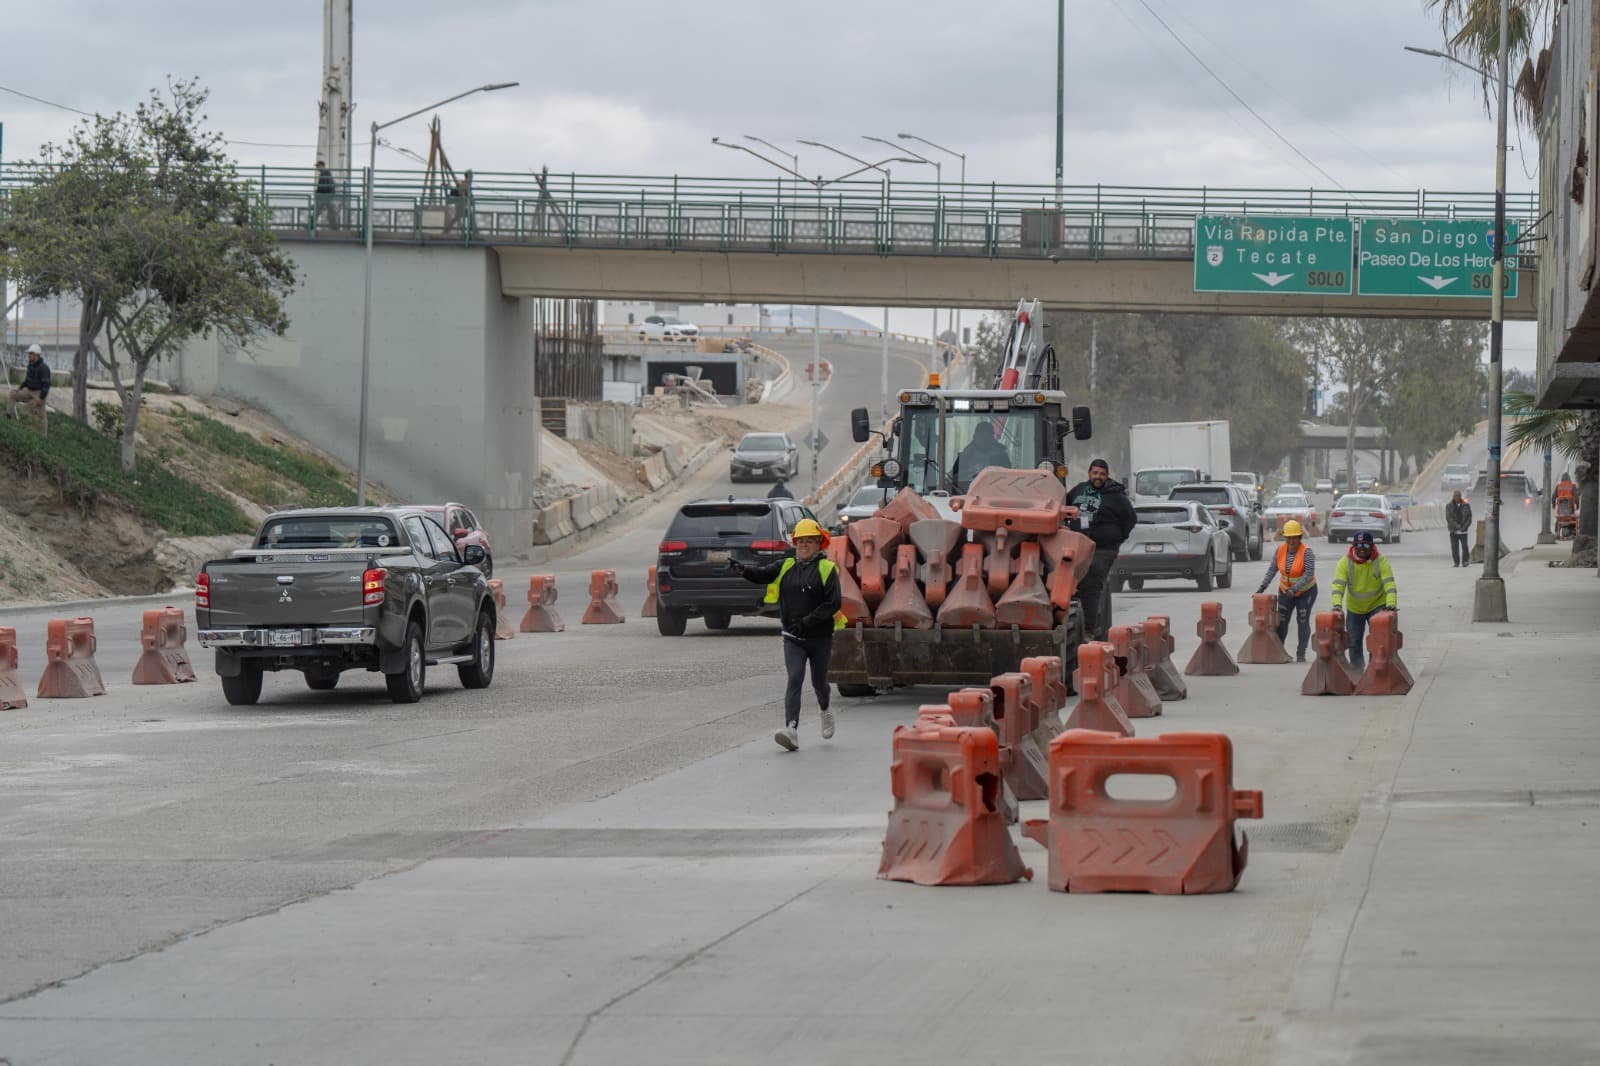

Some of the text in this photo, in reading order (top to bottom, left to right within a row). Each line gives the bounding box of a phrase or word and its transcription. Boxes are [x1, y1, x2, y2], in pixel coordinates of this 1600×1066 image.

[1204, 224, 1347, 245] Via Rapida Pte.
[1375, 228, 1411, 244] San
[1422, 229, 1478, 249] Diego
[1211, 253, 1219, 262] 2
[1236, 248, 1317, 265] Tecate
[1360, 251, 1406, 267] Paseo
[1409, 251, 1430, 267] De
[1434, 252, 1460, 268] Los
[1307, 270, 1344, 287] SOLO
[1472, 274, 1510, 290] SOO
